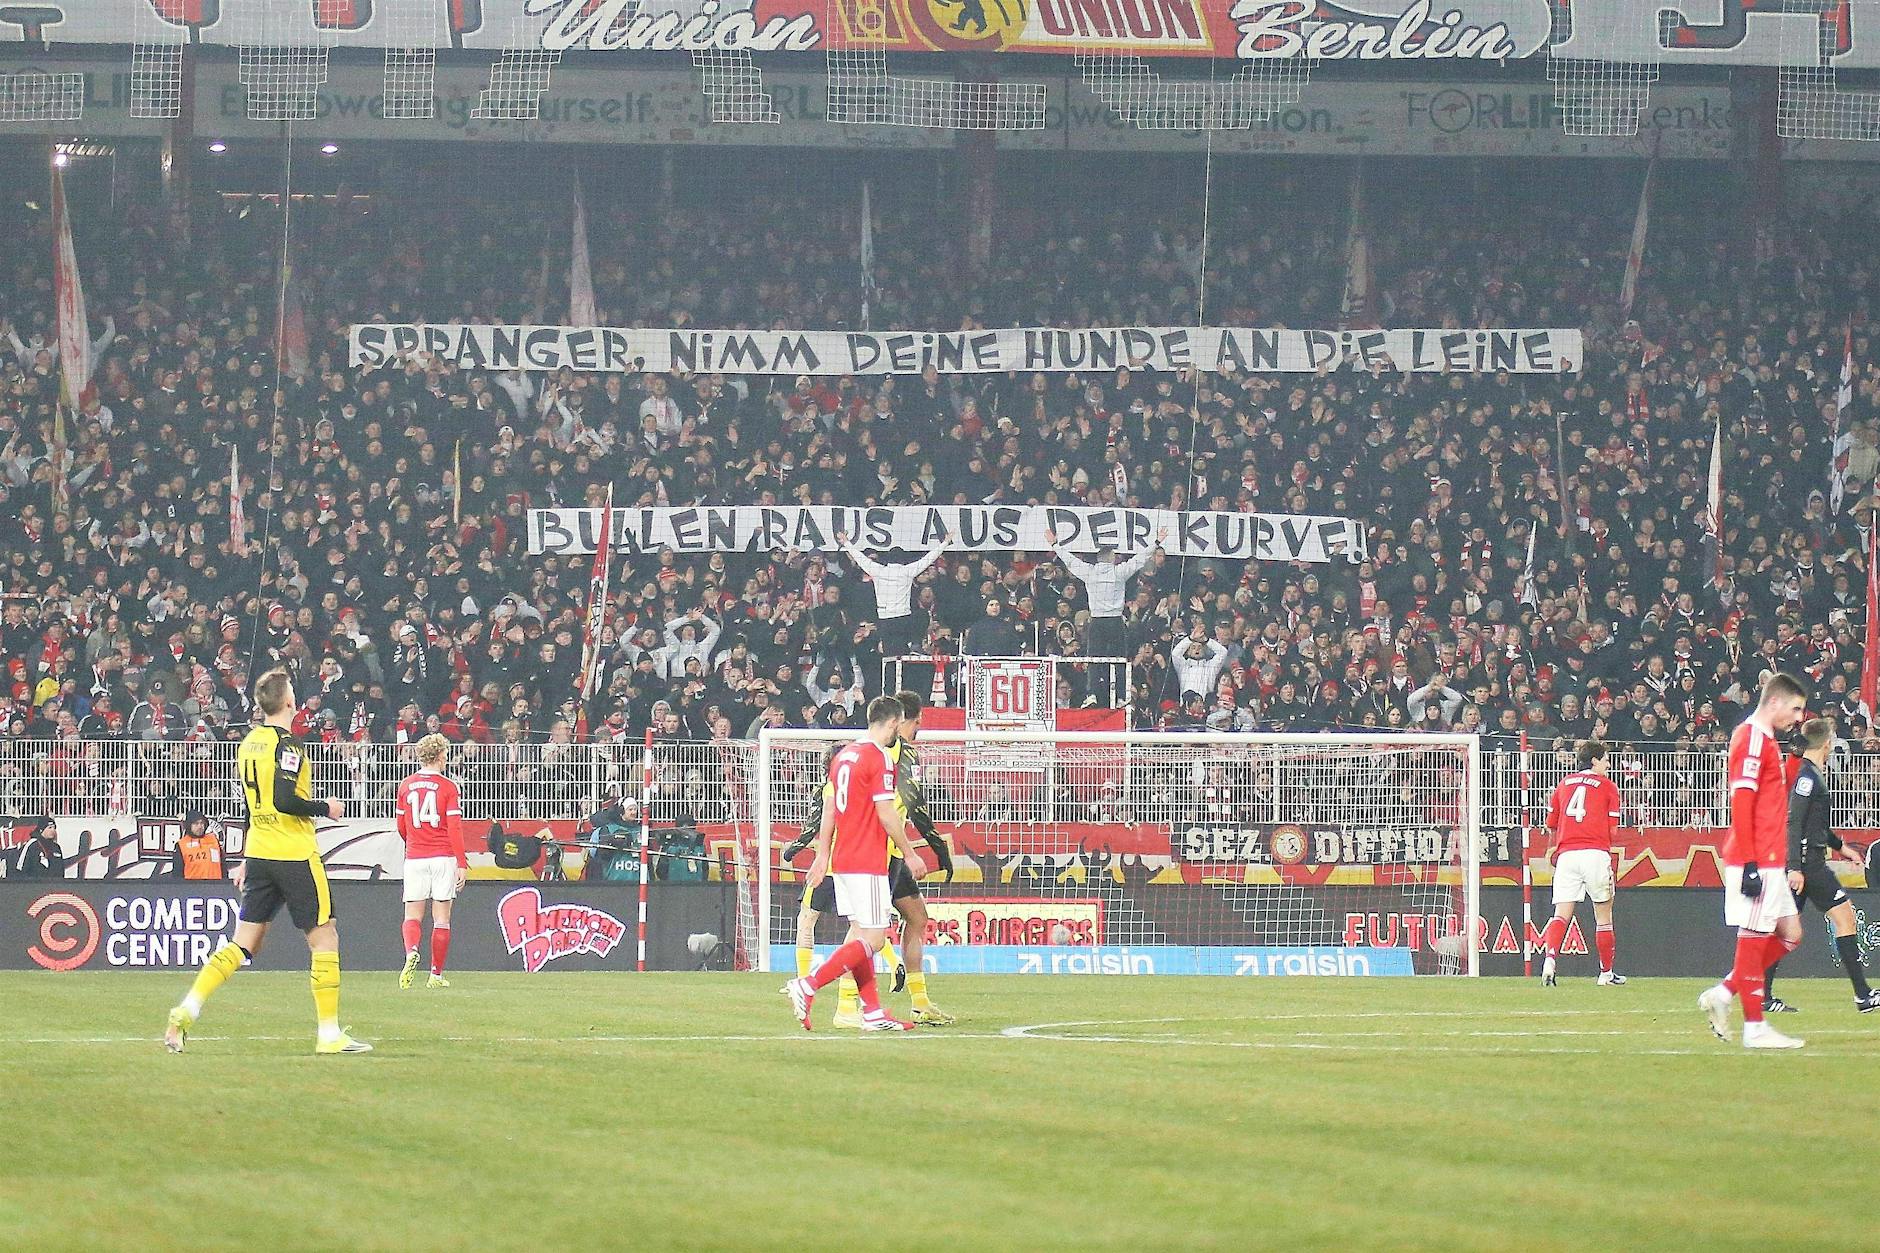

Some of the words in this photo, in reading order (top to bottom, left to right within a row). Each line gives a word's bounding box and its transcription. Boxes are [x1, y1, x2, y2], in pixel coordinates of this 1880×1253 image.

[525, 0, 820, 50] Union
[1231, 0, 1514, 58] Berlin
[1024, 330, 1191, 369] HUNDE
[1216, 329, 1280, 369] AN
[536, 508, 736, 552] BULLEN
[761, 507, 894, 549] RAUS
[921, 507, 1022, 548] AUS
[1045, 507, 1152, 551] DER
[1178, 512, 1363, 563] KURVE!
[991, 675, 1030, 713] 60
[244, 758, 261, 809] 4
[835, 763, 850, 813] 8
[406, 790, 441, 829] 14
[1565, 785, 1587, 823] 4
[188, 851, 208, 862] 242
[615, 860, 640, 872] HOS
[106, 896, 241, 931] COMEDY
[106, 932, 252, 967] CENTRA
[1052, 947, 1156, 975] raisin
[1263, 947, 1371, 977] raisin
